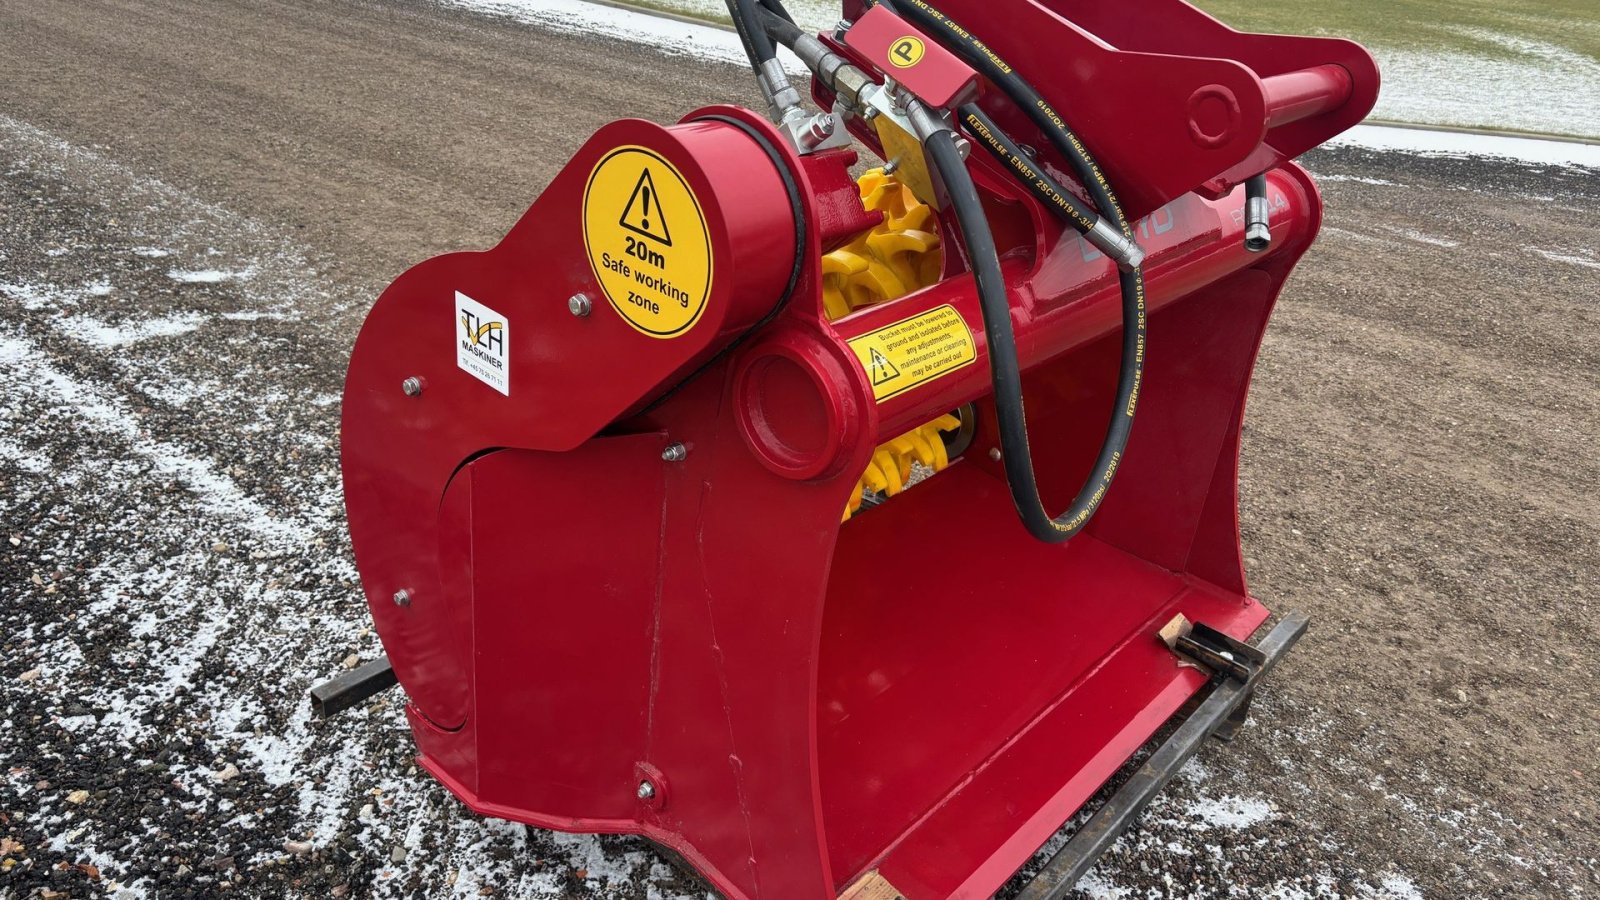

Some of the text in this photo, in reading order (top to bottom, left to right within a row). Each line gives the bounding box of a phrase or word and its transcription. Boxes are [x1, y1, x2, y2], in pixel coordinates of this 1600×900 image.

[928, 7, 944, 20] 2SC
[944, 19, 969, 39] EN857
[893, 41, 912, 62] P
[1037, 99, 1065, 130] 2Q/2019
[1066, 132, 1091, 162] 3120psi
[1010, 156, 1036, 180] EN857
[1036, 179, 1053, 196] 2SC
[1051, 193, 1072, 214] DN19
[1092, 165, 1105, 184] MPa
[1115, 205, 1125, 221] bar
[1120, 221, 1131, 238] 215
[625, 236, 665, 270] 20m
[602, 252, 689, 308] Safe working
[628, 291, 660, 315] zone
[1136, 285, 1144, 310] DN19
[461, 308, 503, 357] TLH
[878, 329, 901, 341] Bucket
[901, 323, 917, 333] must
[915, 320, 924, 328] be
[923, 312, 947, 324] lowered
[1137, 311, 1145, 329] 2SC
[886, 318, 960, 352] ground and isolated before
[1135, 334, 1144, 362] EN857
[462, 340, 503, 371] MASKINER
[900, 350, 936, 370] maintenance
[944, 338, 967, 352] cleaning
[905, 346, 917, 355] any
[912, 351, 962, 378] may be carried out
[1103, 451, 1120, 482] 2Q/2019
